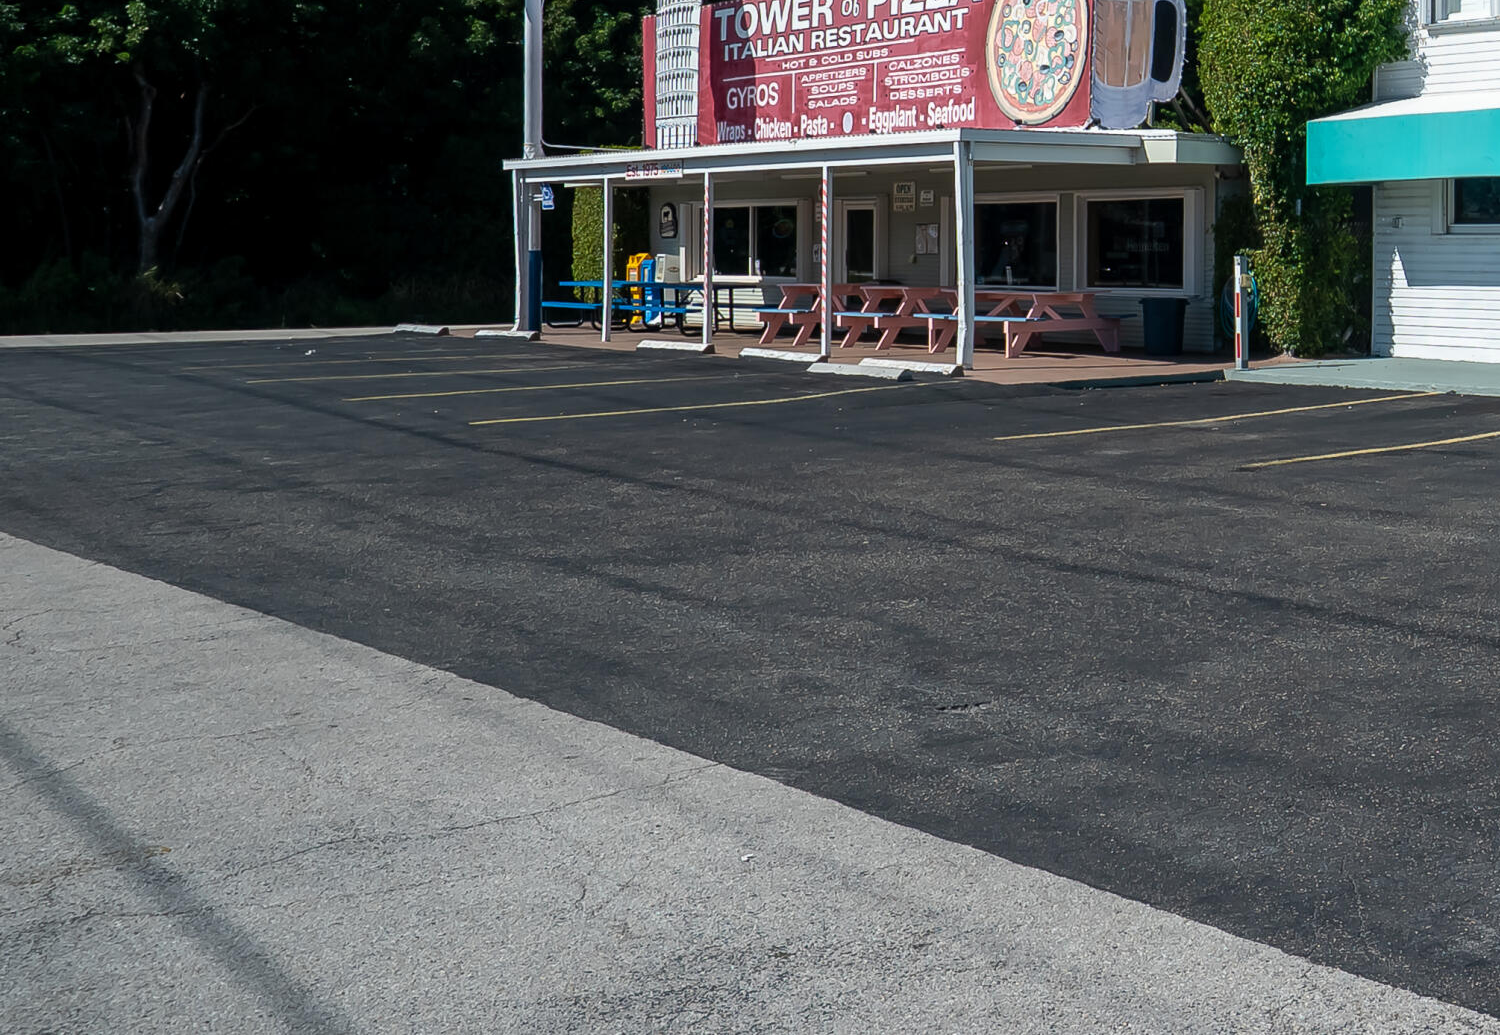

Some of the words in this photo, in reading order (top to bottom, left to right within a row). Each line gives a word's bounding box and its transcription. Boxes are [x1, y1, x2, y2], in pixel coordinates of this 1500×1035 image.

[724, 33, 804, 62] ITALIAN
[811, 7, 969, 51] RESTAURANT
[782, 59, 805, 70] HOT
[809, 58, 818, 66] &
[821, 52, 853, 65] COLD
[856, 48, 889, 61] SUBS
[888, 53, 960, 71] CALZONES
[801, 67, 867, 83] APPETIZERS
[884, 67, 970, 86] STROMBOLIS
[726, 82, 779, 110] GYROS
[811, 82, 855, 95] SOUPS
[890, 85, 962, 100] DESSERTS
[807, 96, 857, 109] SALADS
[717, 121, 745, 142] Wraps
[754, 117, 792, 140] Chicken
[801, 112, 828, 136] Pasta
[869, 105, 917, 133] Eggplant
[927, 96, 975, 126] Seafood
